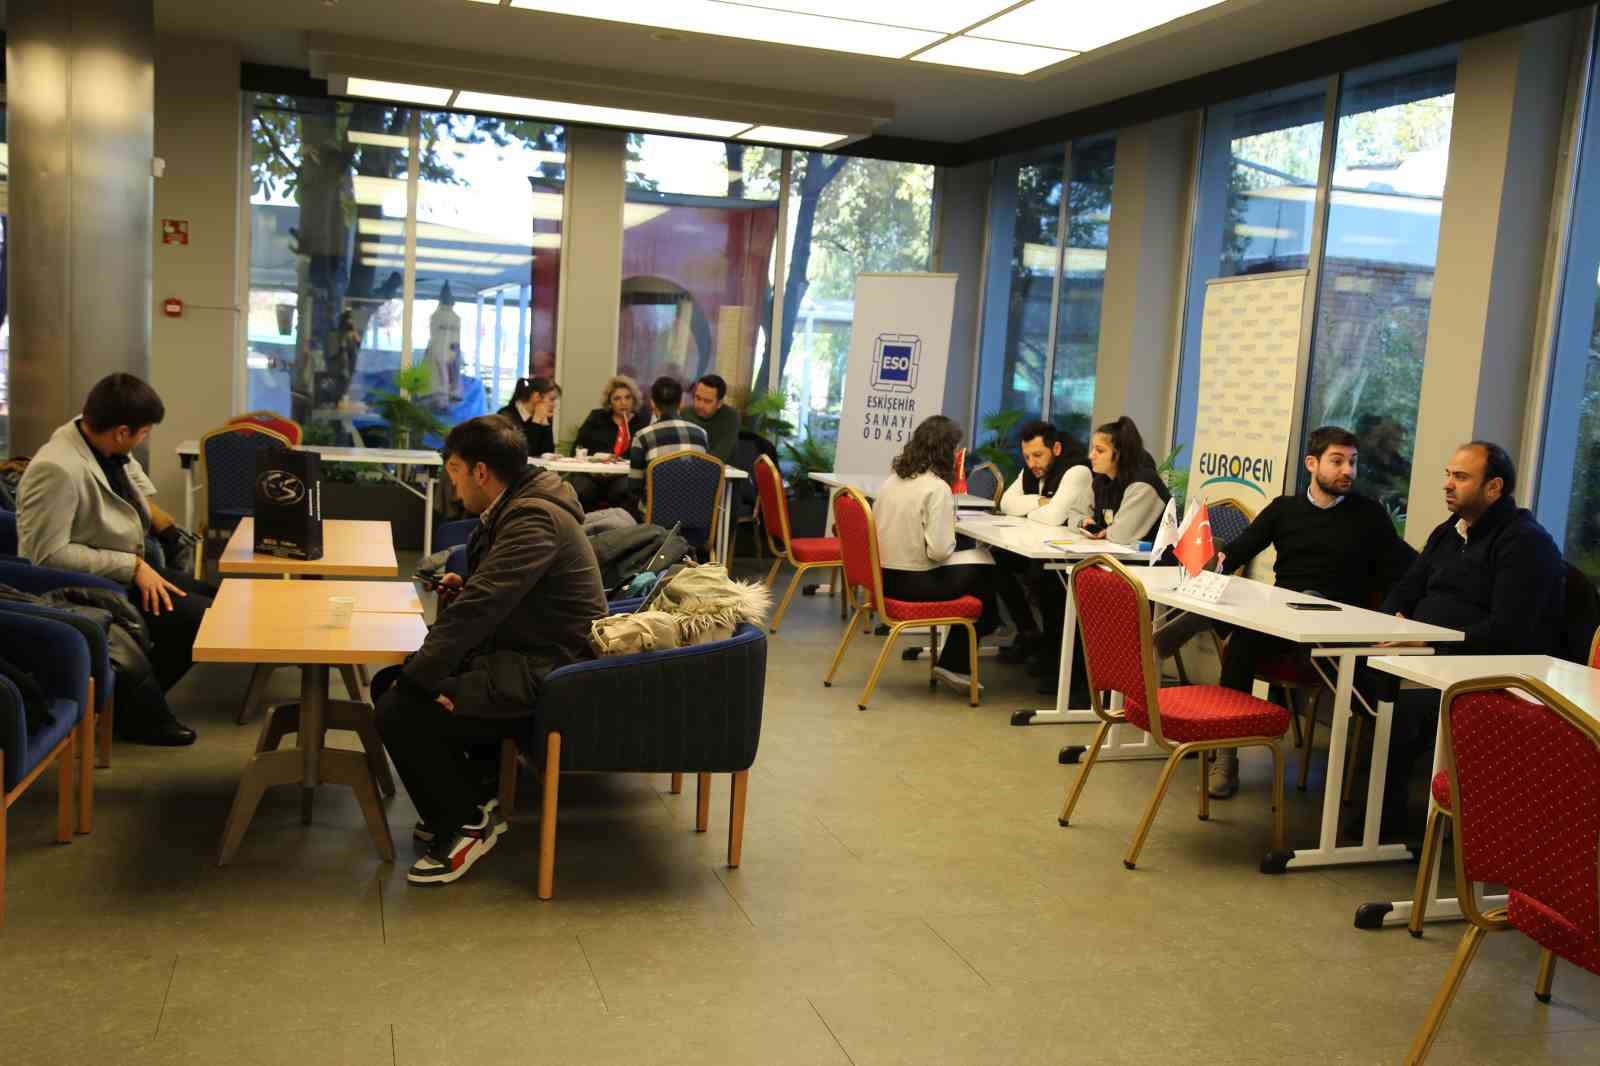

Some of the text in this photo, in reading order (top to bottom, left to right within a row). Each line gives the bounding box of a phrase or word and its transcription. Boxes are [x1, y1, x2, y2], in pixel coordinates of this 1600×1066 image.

[883, 356, 909, 370] ESO
[867, 394, 915, 412] ESKİŞEHİR
[865, 412, 913, 429] SANAYİ
[863, 427, 911, 442] ODASI
[1199, 452, 1273, 483] EUROPEN
